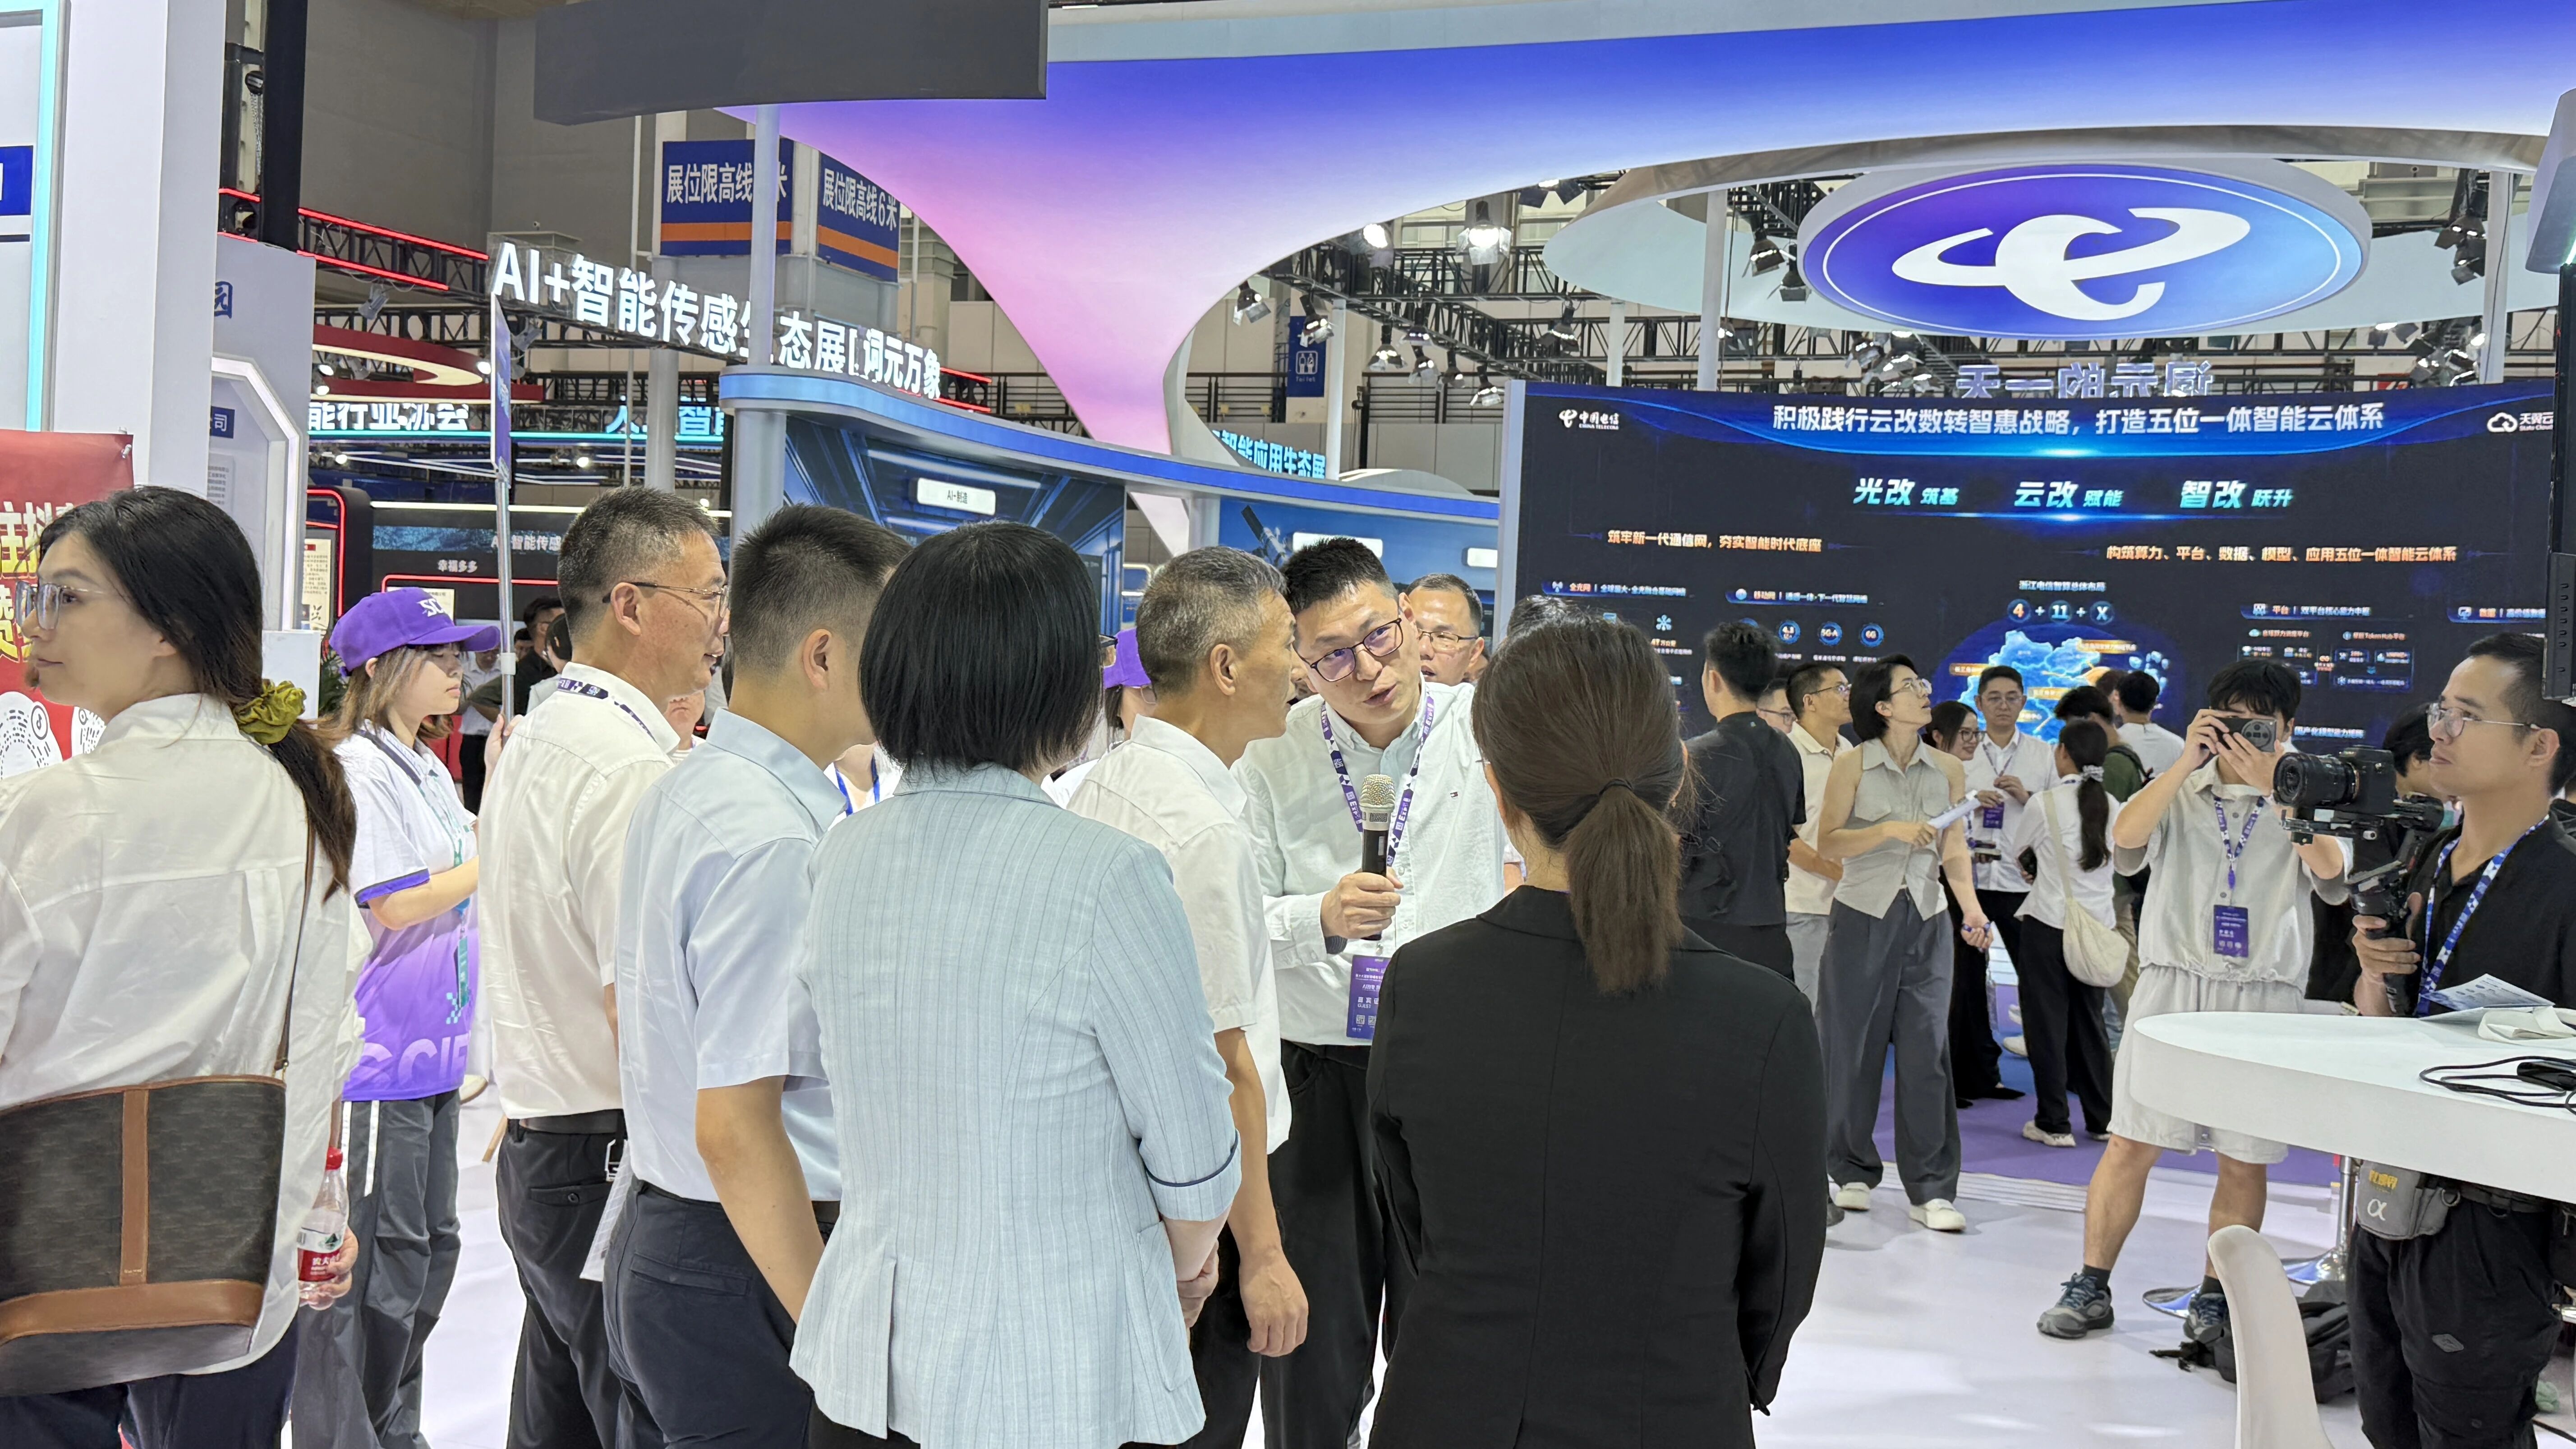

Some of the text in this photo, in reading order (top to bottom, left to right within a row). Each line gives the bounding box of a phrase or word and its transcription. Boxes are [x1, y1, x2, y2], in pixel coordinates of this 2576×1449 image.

[667, 161, 788, 204] 展位限高线米
[823, 168, 897, 230] 展位限高线6米
[1579, 411, 1619, 425] 中国电信
[2519, 412, 2554, 425] 天翼云
[1853, 478, 2293, 509] 光改 筑基 云改 赋能 智改 跃升
[2013, 603, 2024, 619] 4
[2052, 604, 2068, 620] 11
[2096, 605, 2109, 621] X
